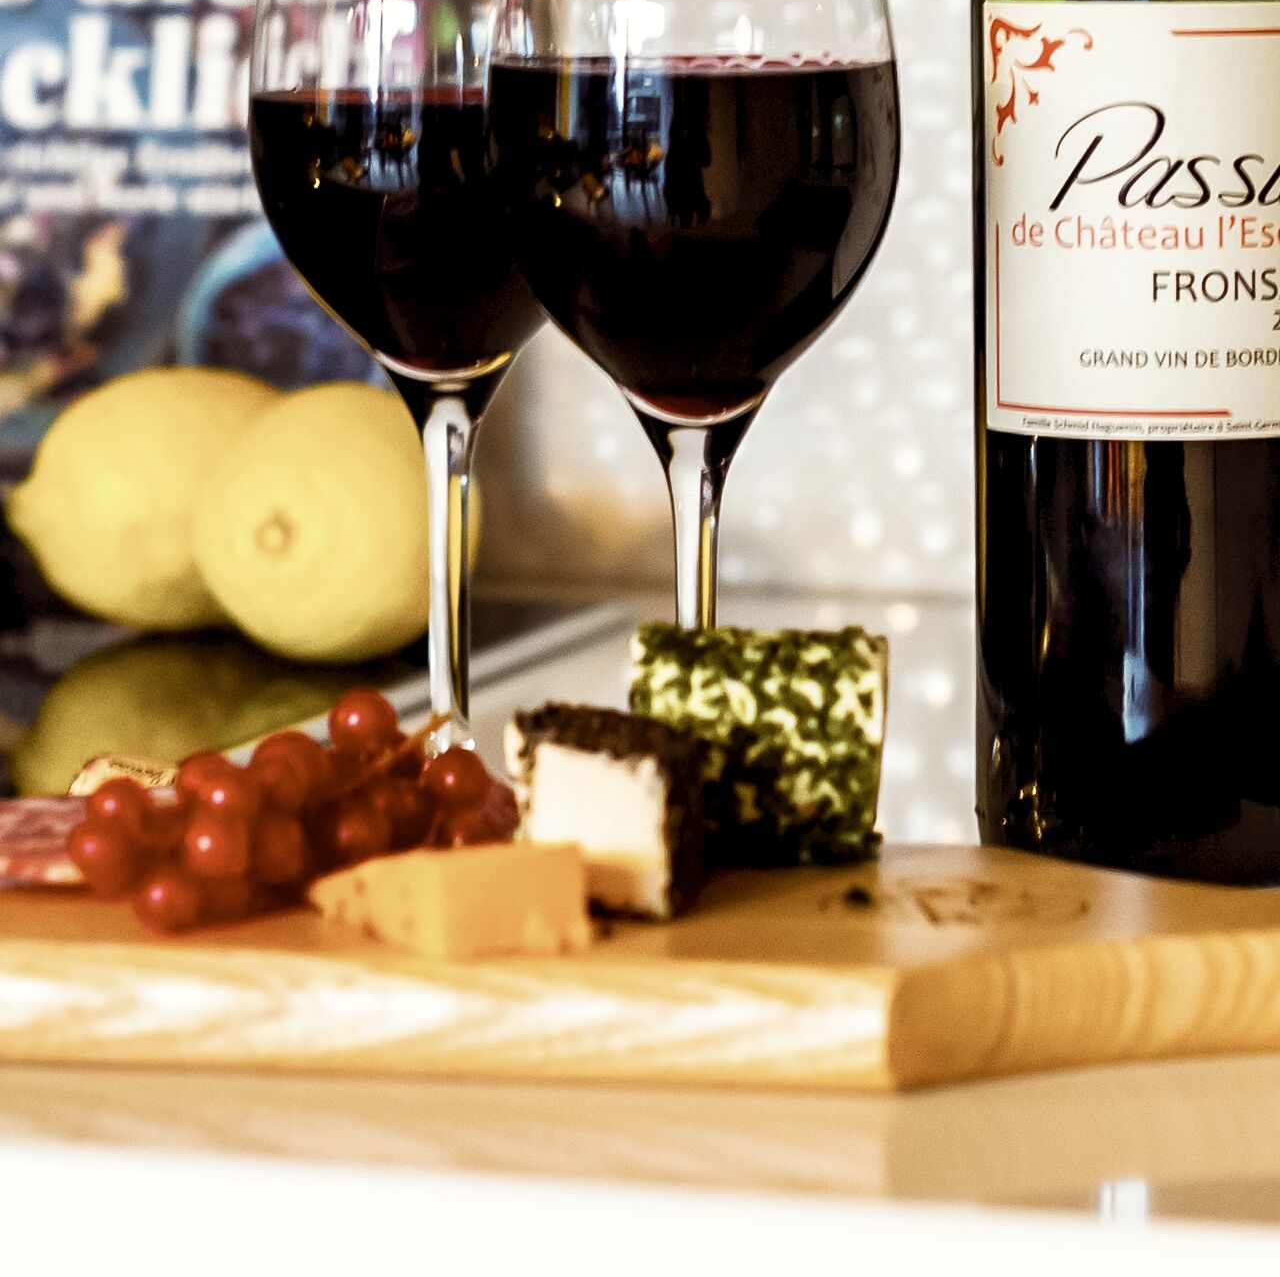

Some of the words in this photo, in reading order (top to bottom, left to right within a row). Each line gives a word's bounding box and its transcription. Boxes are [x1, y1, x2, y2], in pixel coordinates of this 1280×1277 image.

[1011, 212, 1045, 248] de
[1055, 213, 1205, 251] Château
[1079, 347, 1150, 370] GRAND
[1154, 348, 1189, 370] VIN
[1194, 348, 1221, 370] DE
